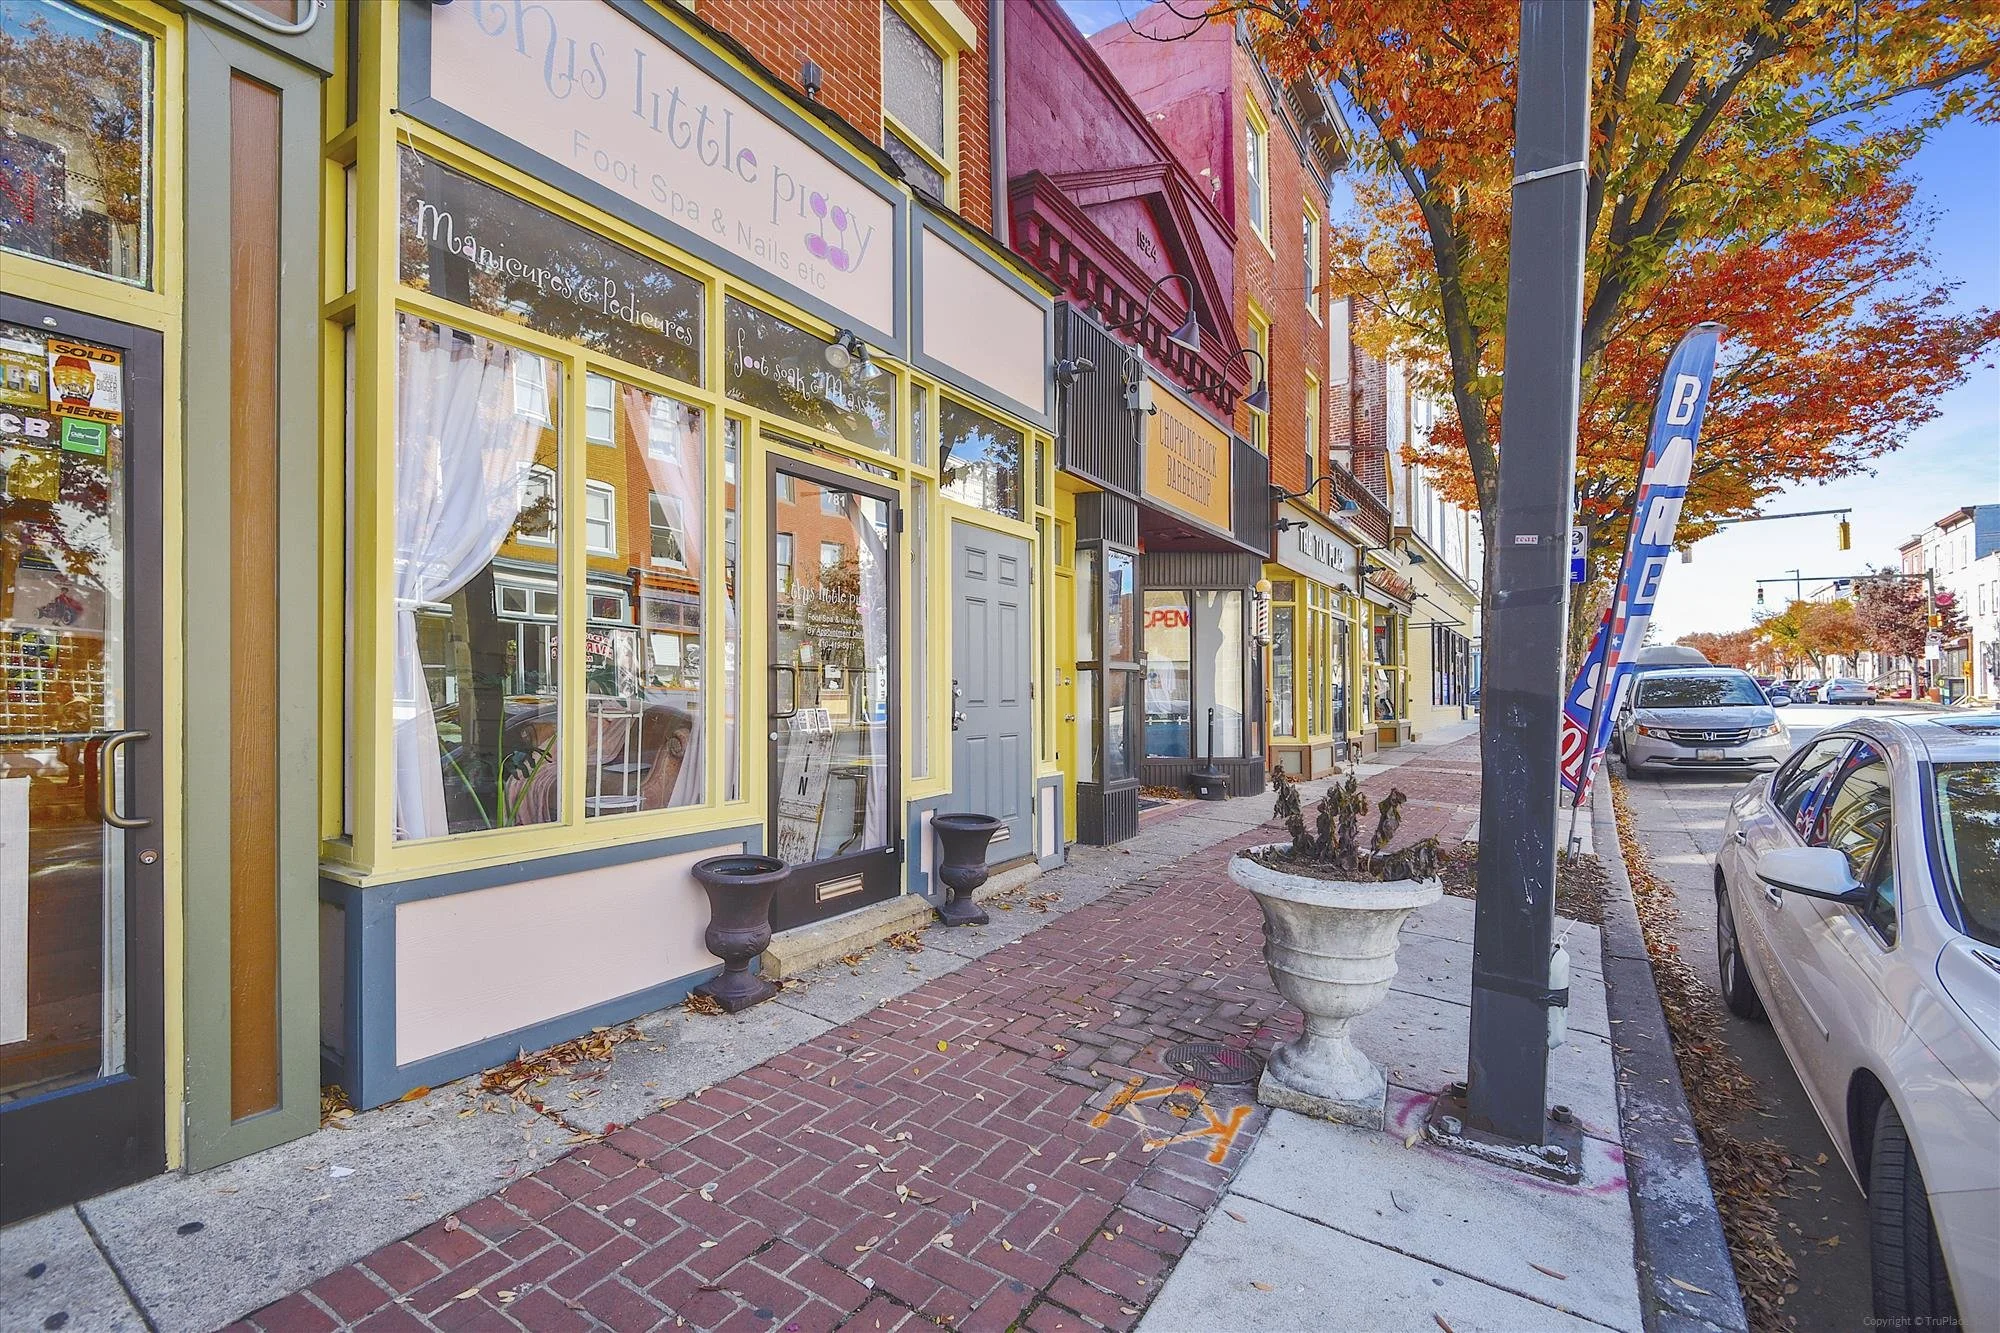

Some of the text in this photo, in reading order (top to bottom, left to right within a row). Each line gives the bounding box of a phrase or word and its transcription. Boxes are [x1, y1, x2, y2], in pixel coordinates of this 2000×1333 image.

[632, 48, 757, 183] little
[573, 129, 827, 291] Foot Spa & Nails etc
[416, 200, 693, 346] Manicures & Pedicures
[54, 344, 116, 363] SOLD
[734, 328, 769, 378] foot
[774, 364, 811, 401] soak
[811, 379, 824, 394] &
[55, 403, 119, 422] HERE
[1159, 408, 1217, 478] CHOPPING BLOCK
[1167, 454, 1212, 508] BARBERSHOP
[818, 582, 847, 604] little
[807, 613, 821, 622] Foot
[822, 615, 834, 624] Spa
[807, 627, 815, 636] By
[816, 628, 851, 638] Appointment
[1144, 609, 1190, 629] OPEN
